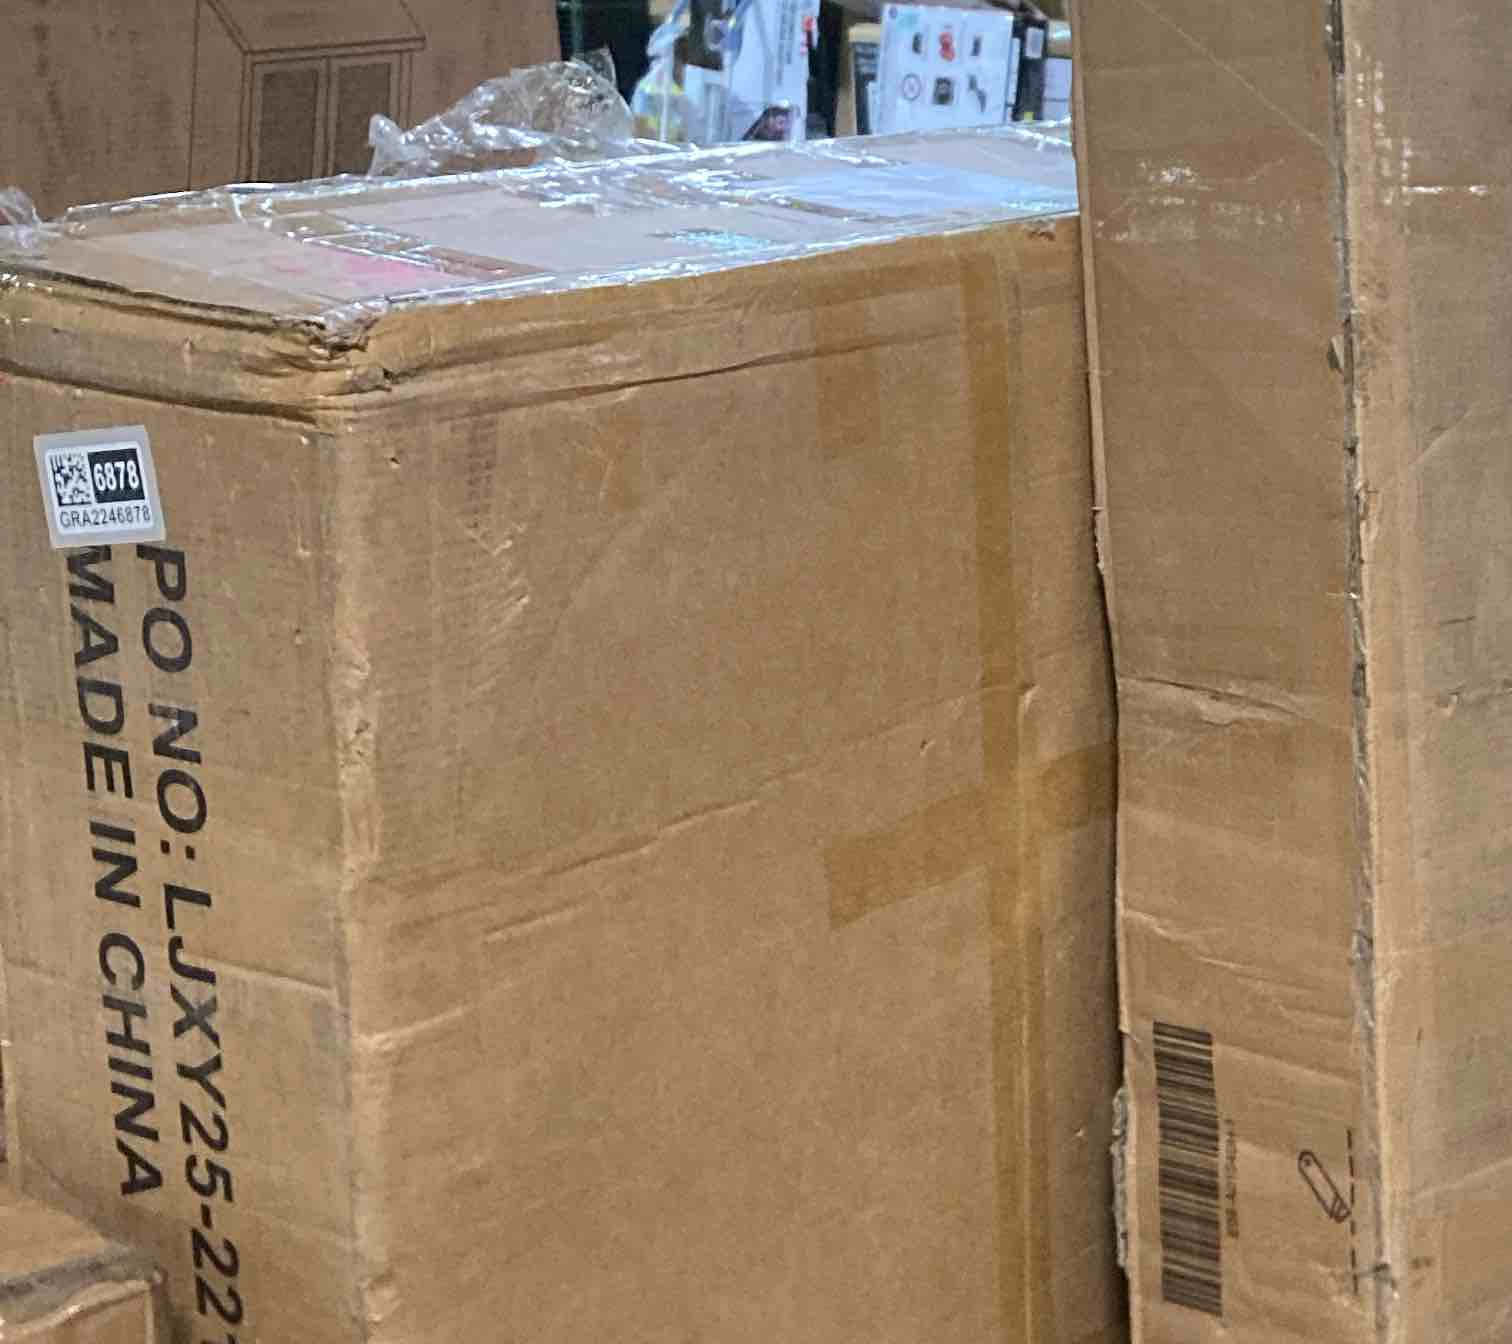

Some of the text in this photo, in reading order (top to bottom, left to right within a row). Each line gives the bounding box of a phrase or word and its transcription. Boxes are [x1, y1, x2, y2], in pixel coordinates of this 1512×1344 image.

[59, 504, 151, 529] GRA2246878
[93, 459, 140, 492] 6878
[136, 543, 193, 674] PO
[148, 702, 208, 860] NO:
[66, 544, 164, 1197] MADE IN CHINA
